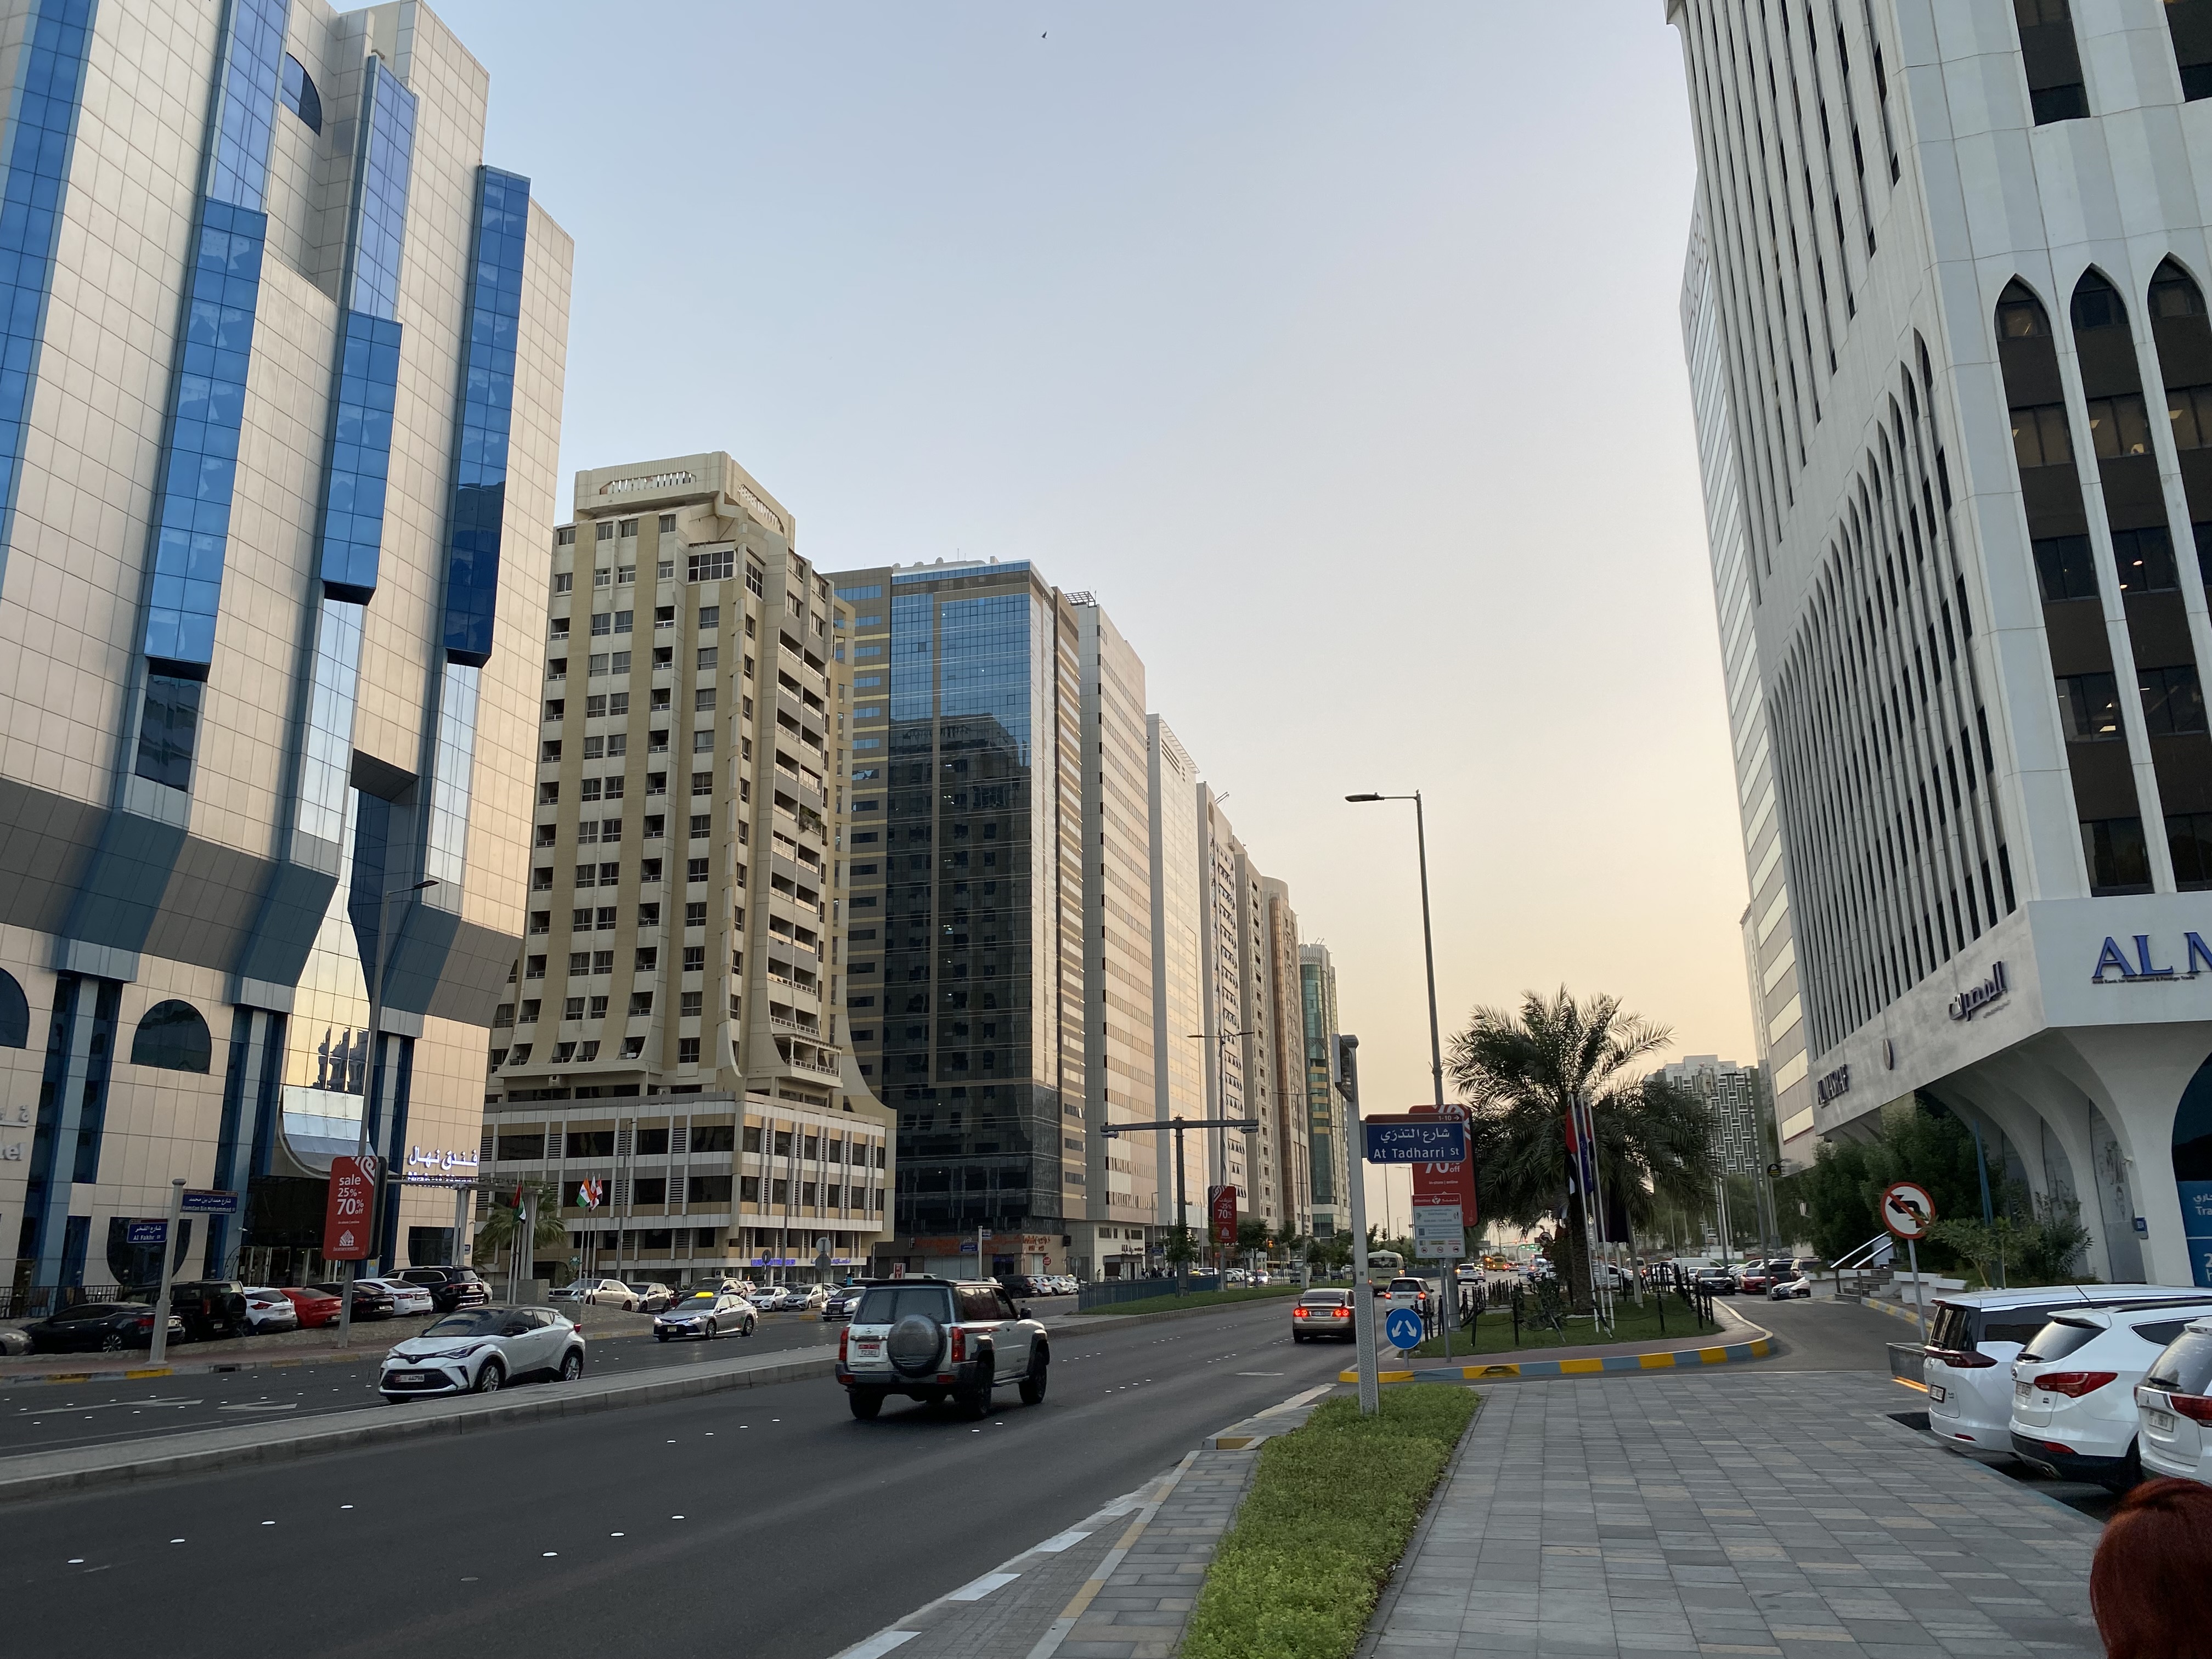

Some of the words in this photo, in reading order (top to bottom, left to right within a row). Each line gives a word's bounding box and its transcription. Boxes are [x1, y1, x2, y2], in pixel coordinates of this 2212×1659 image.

[2092, 934, 2174, 978] AL
[1423, 1127, 1450, 1143] شارع
[409, 1146, 441, 1169] نهال
[442, 1149, 478, 1171] فندق
[1373, 1148, 1386, 1159] At
[1392, 1147, 1444, 1159] Tadharri
[1450, 1147, 1460, 1156] St
[338, 1173, 362, 1186] sale
